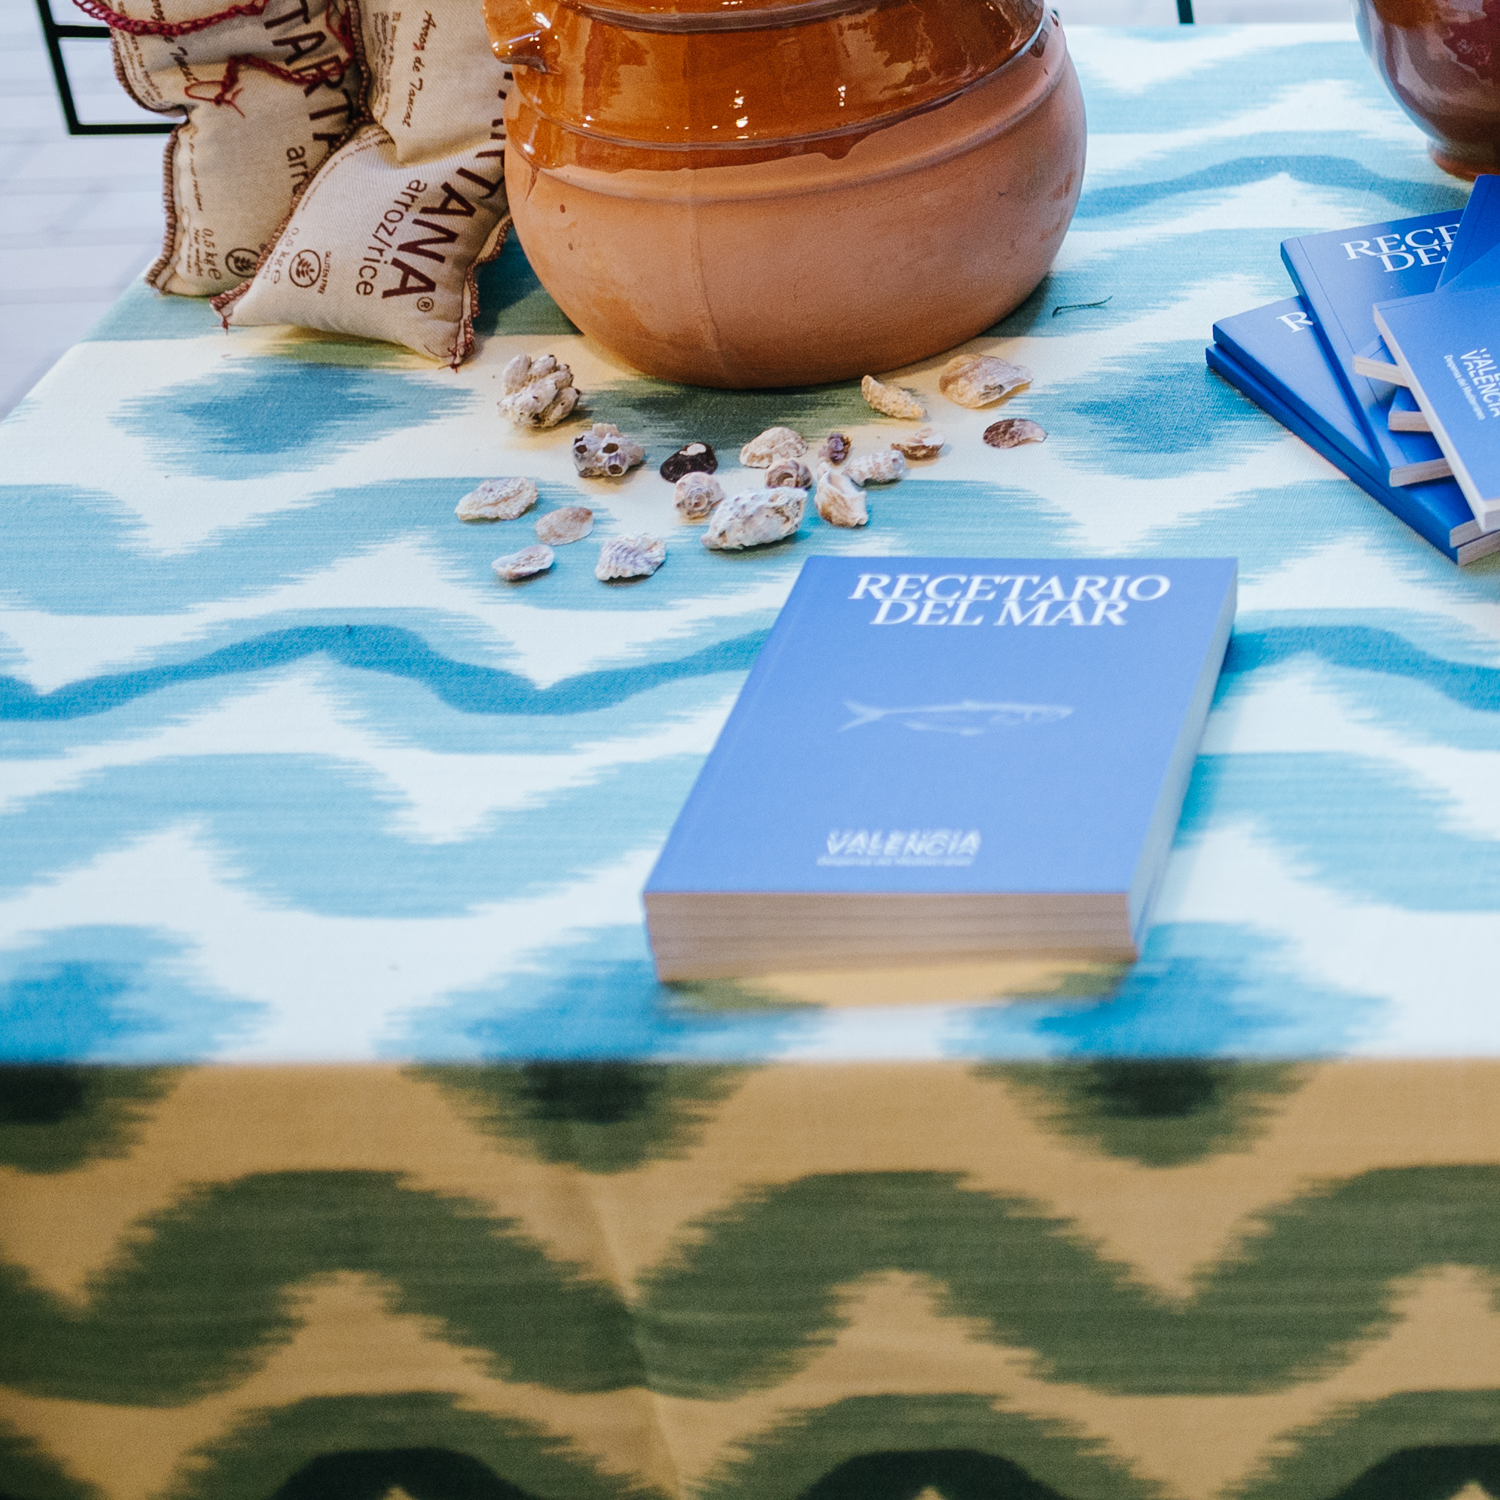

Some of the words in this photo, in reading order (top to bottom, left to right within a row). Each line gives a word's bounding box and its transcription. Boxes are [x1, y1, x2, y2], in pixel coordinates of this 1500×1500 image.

[412, 56, 425, 73] de
[202, 227, 215, 250] 0,5
[1340, 223, 1461, 261] RECE
[847, 573, 1171, 602] RECETARIO
[869, 599, 985, 626] DEL
[993, 600, 1129, 627] MAR
[827, 829, 982, 856] VALENCIA
